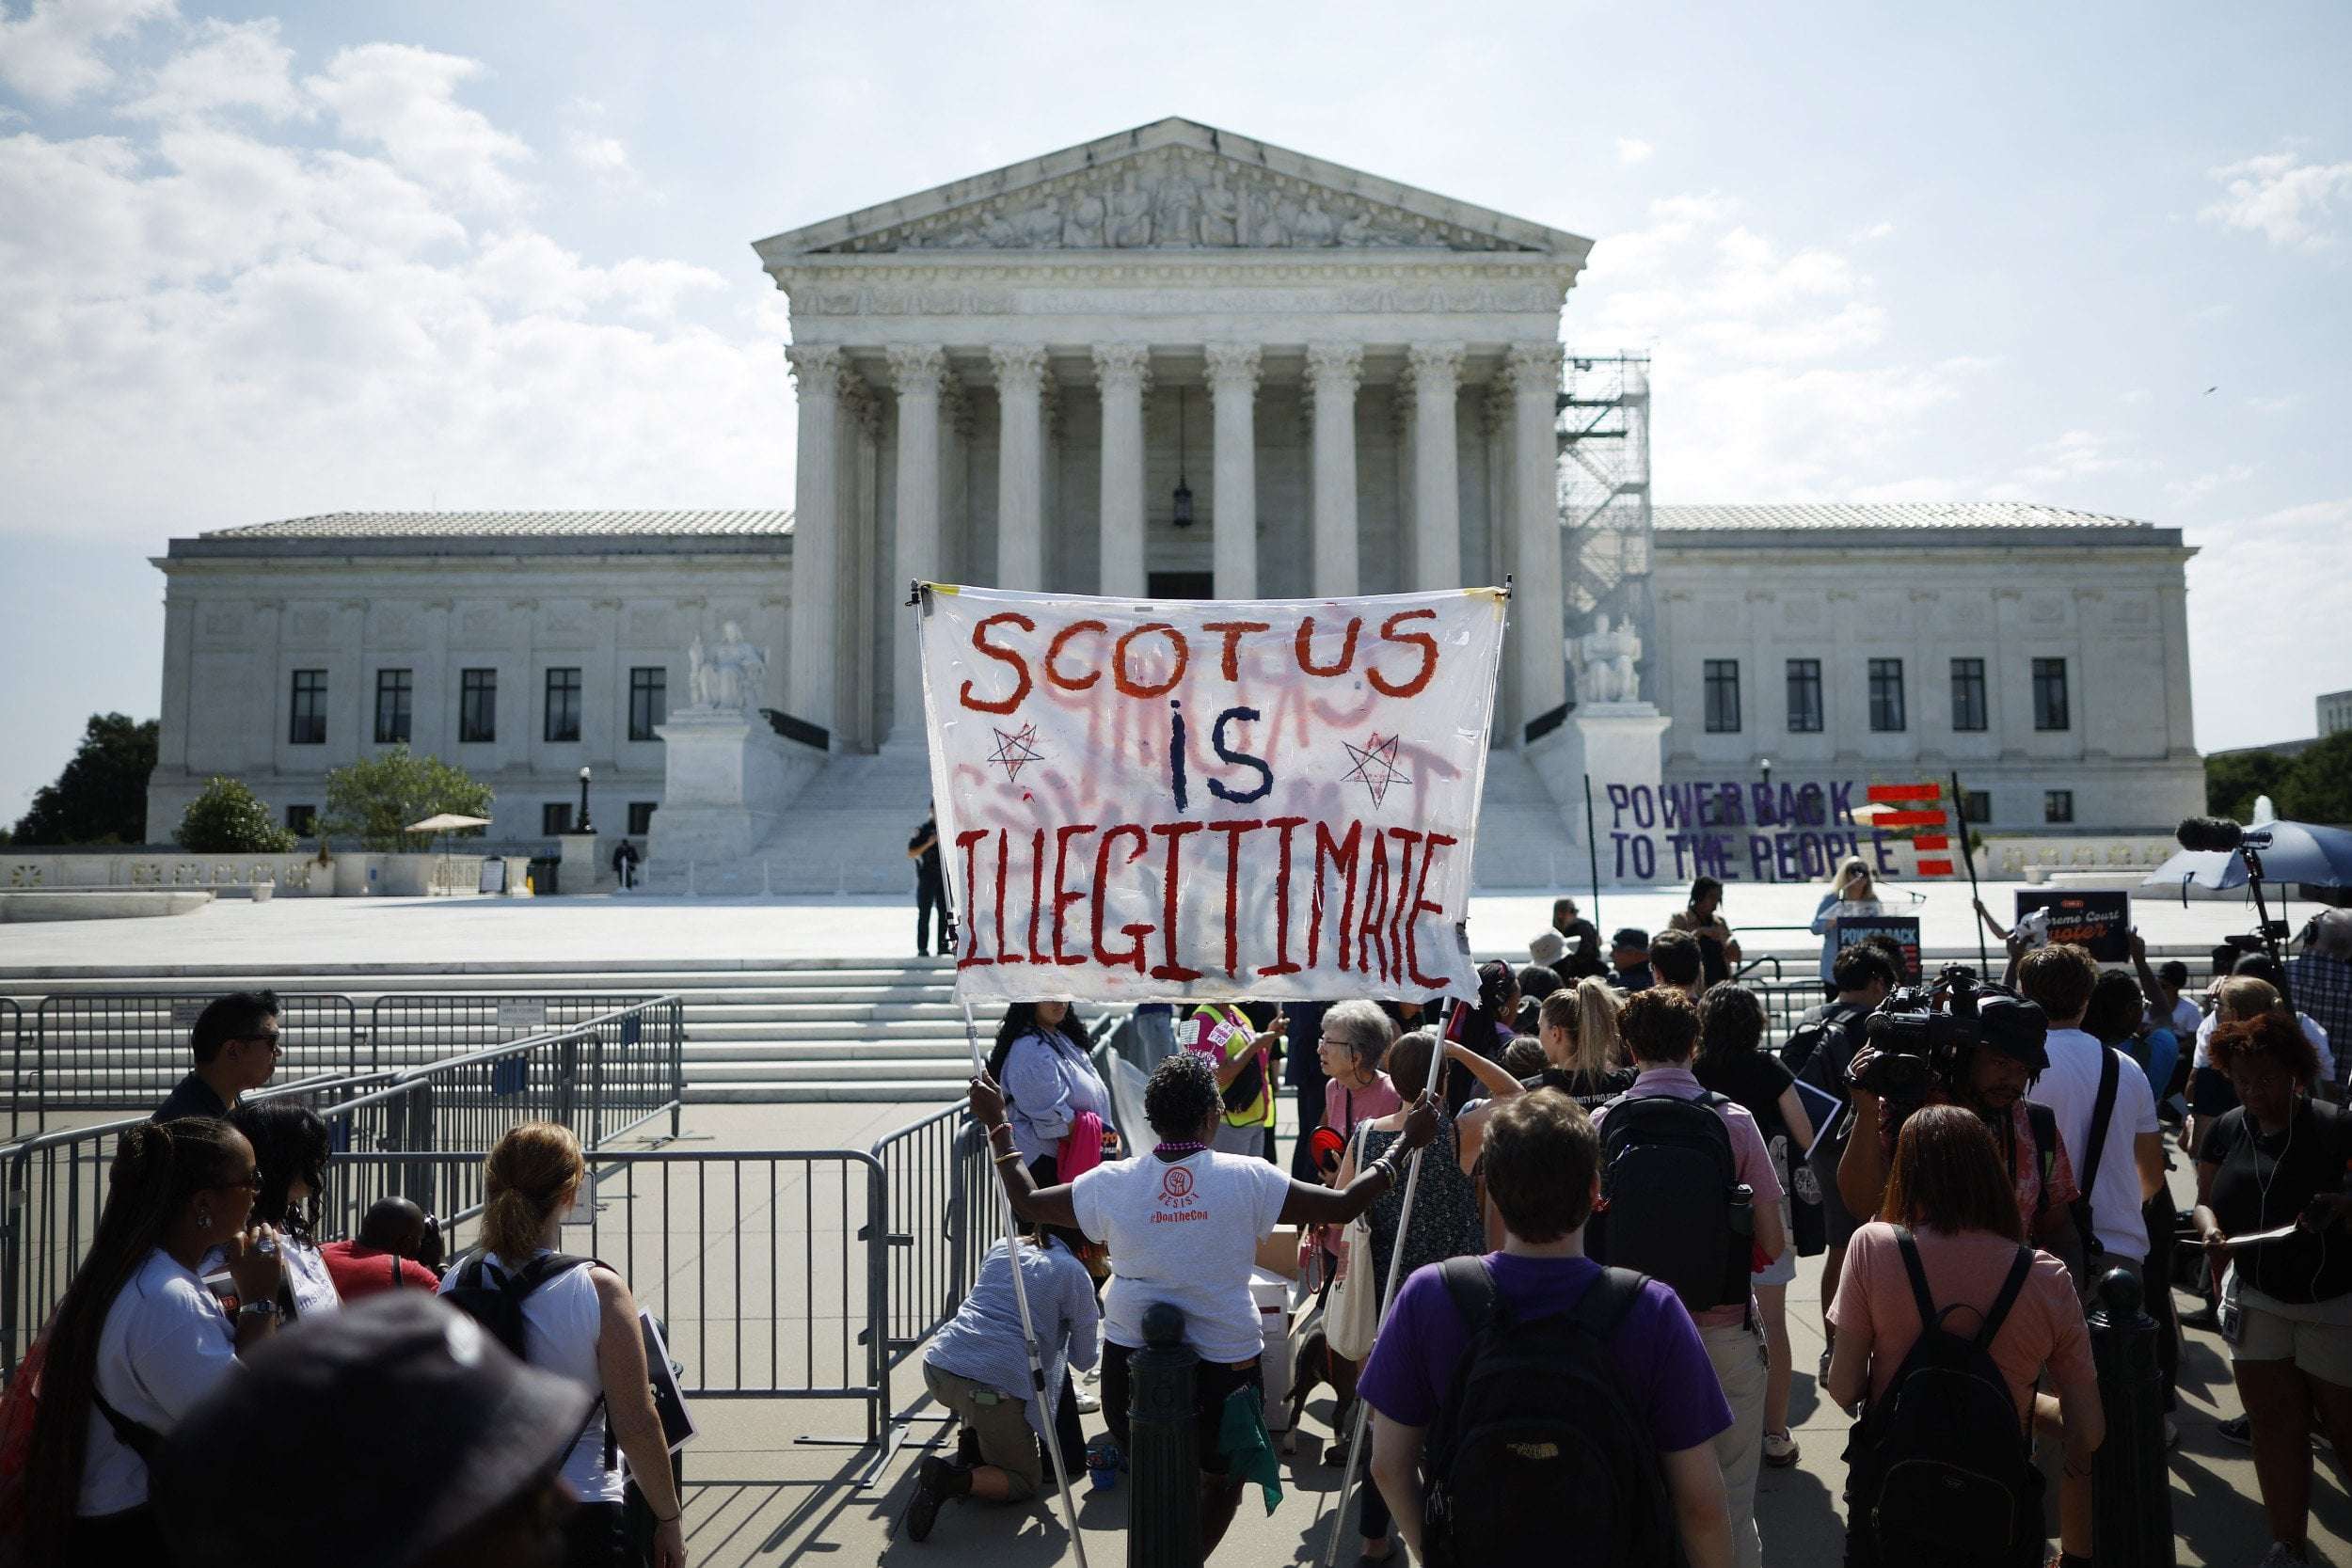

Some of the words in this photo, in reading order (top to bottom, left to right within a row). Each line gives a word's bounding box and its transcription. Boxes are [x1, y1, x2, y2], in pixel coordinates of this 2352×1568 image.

[961, 609, 1438, 715] SCOTUS
[1607, 781, 1747, 829] POWER
[1751, 781, 1856, 828] BACK
[1611, 832, 1656, 879] TO
[1666, 833, 1740, 879] THE
[956, 816, 1458, 990] ILLEGITIMATE
[1158, 1192, 1200, 1209] RESIST
